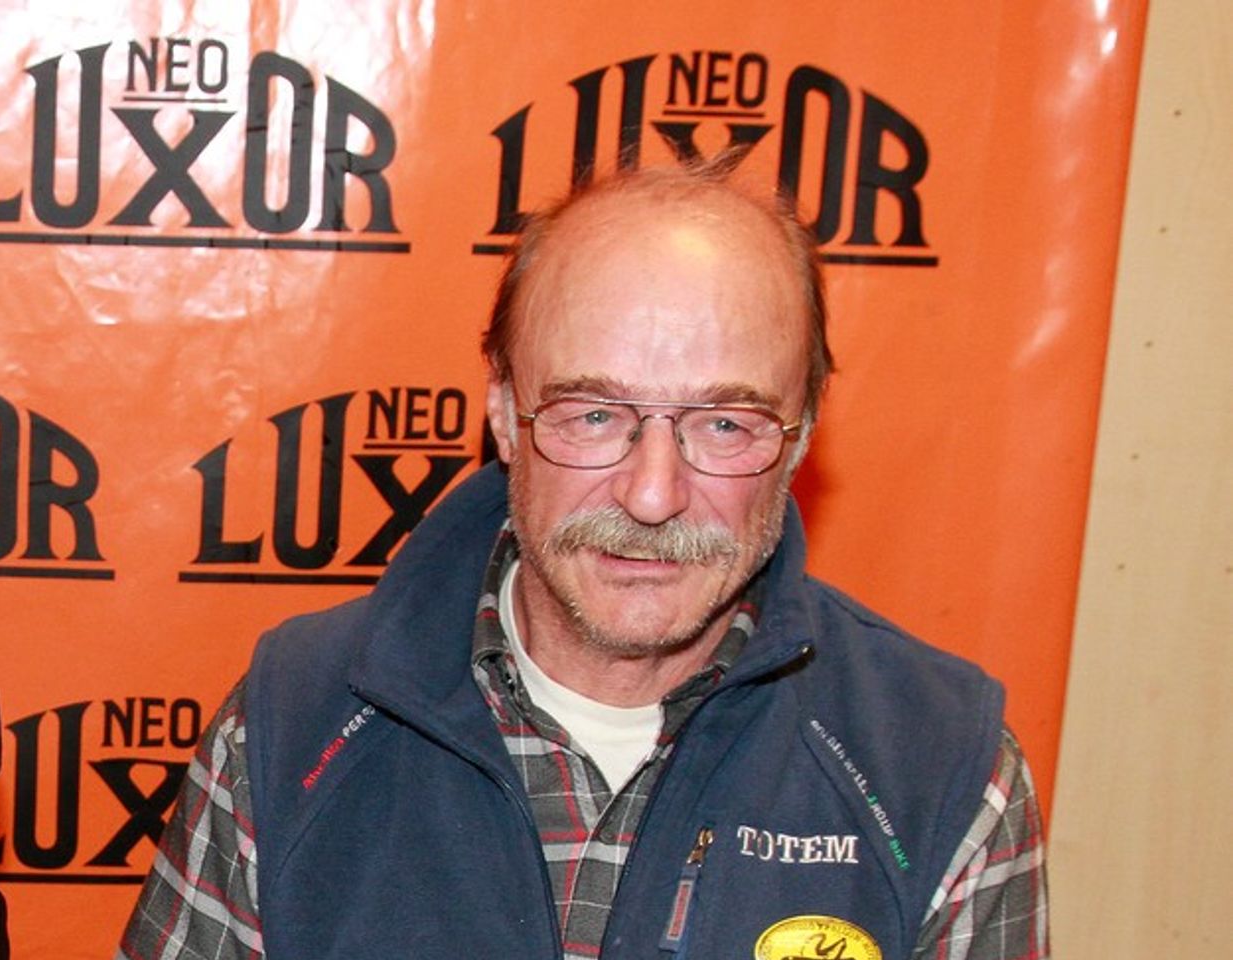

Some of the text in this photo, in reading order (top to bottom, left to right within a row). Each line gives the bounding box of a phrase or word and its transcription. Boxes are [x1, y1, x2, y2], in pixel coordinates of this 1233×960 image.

[126, 38, 229, 94] NEO
[667, 50, 770, 109] NEO
[367, 388, 468, 441] NEO
[190, 390, 508, 571] LUX
[101, 697, 203, 749] NEO
[737, 824, 859, 865] TOTEM
